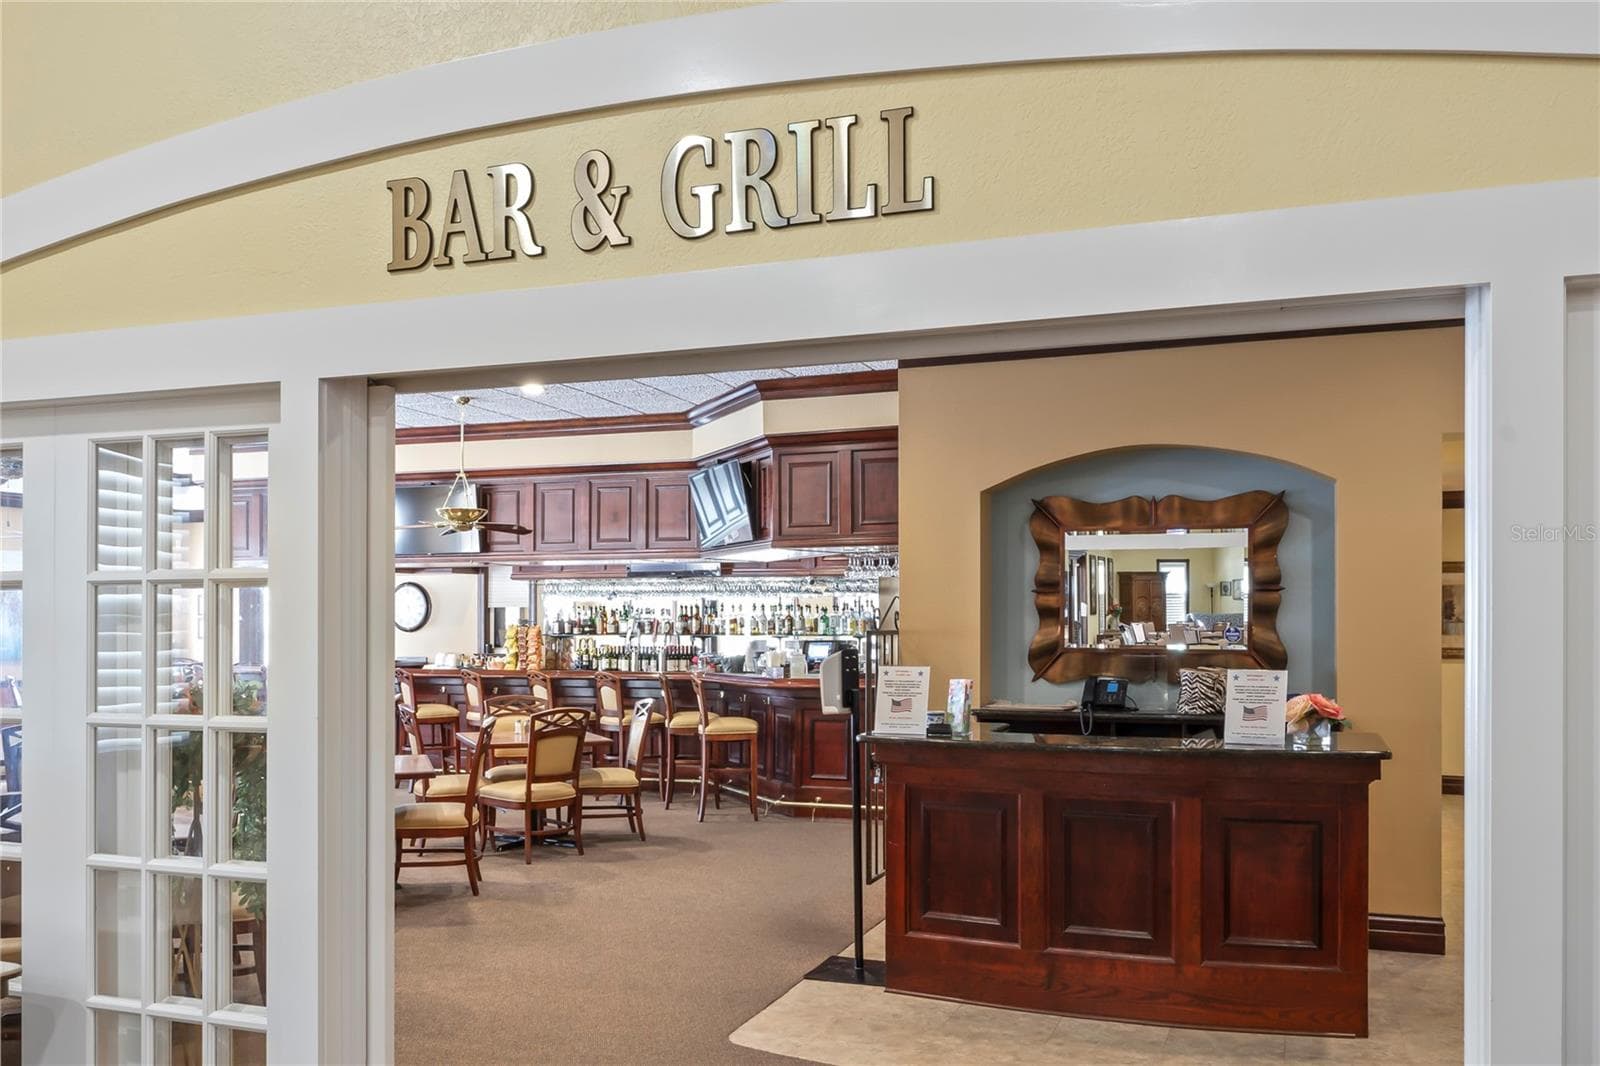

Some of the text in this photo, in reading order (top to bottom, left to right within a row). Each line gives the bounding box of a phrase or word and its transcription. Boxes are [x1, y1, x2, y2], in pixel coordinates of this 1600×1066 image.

[386, 106, 935, 273] BAR & GRILL
